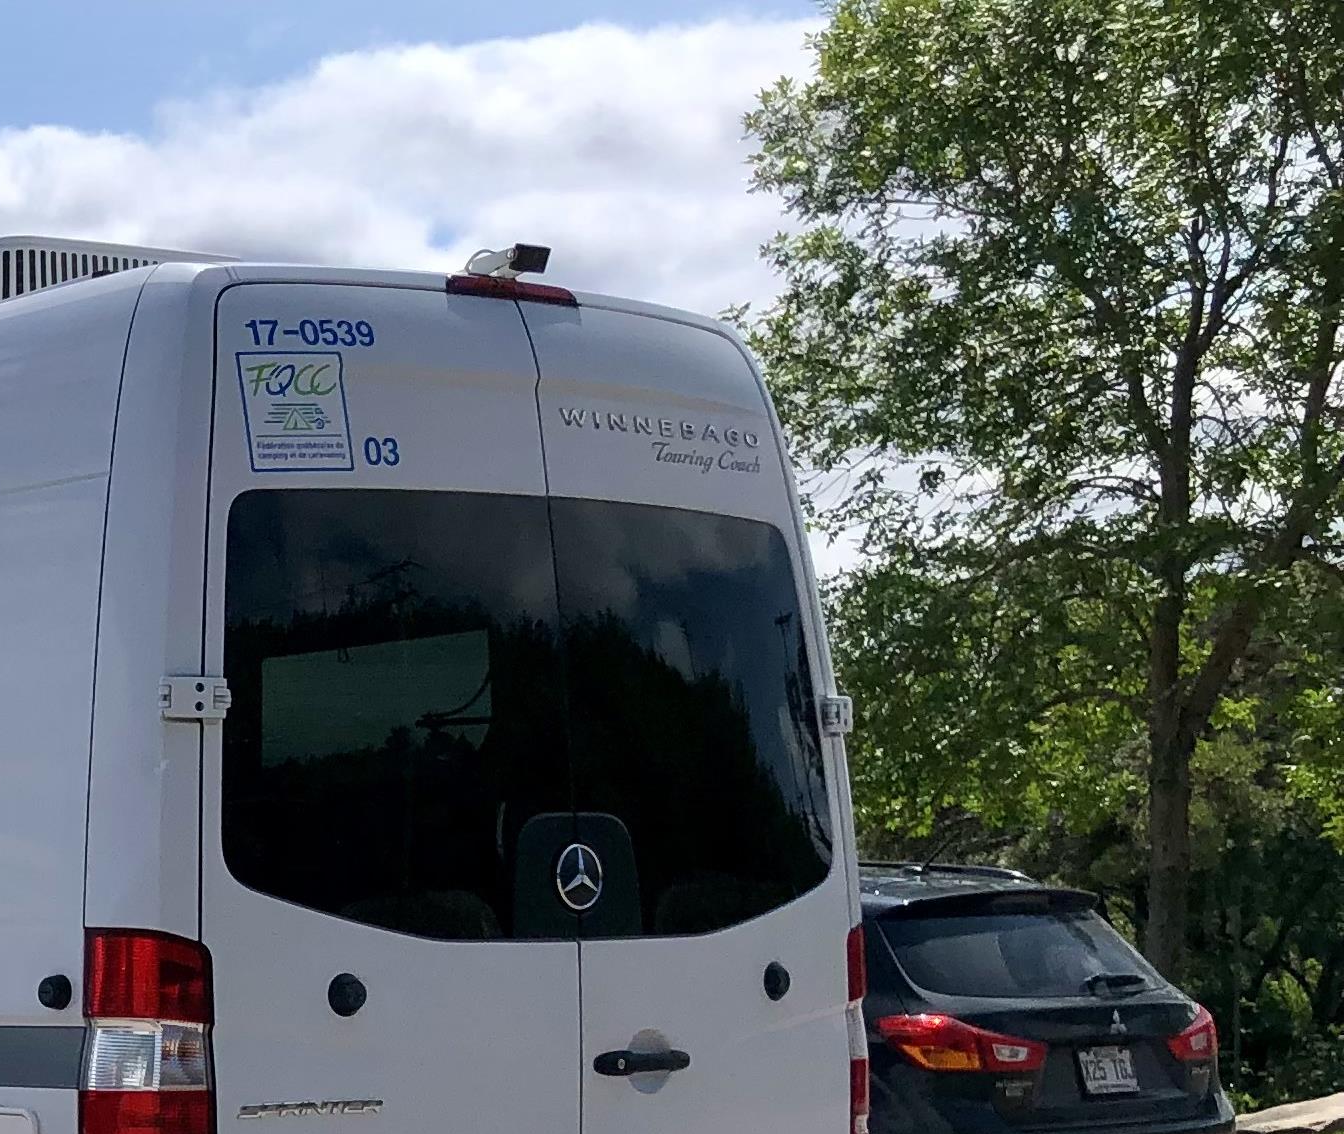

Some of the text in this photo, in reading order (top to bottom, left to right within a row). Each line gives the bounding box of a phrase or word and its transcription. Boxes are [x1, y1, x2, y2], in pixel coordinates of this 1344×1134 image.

[245, 320, 374, 346] 17-0539
[246, 362, 337, 397] FQCC
[559, 407, 760, 448] WINNEBAGO
[364, 437, 400, 466] 03
[652, 442, 760, 474] Touring Coach
[237, 1099, 383, 1119] SPRINTER
